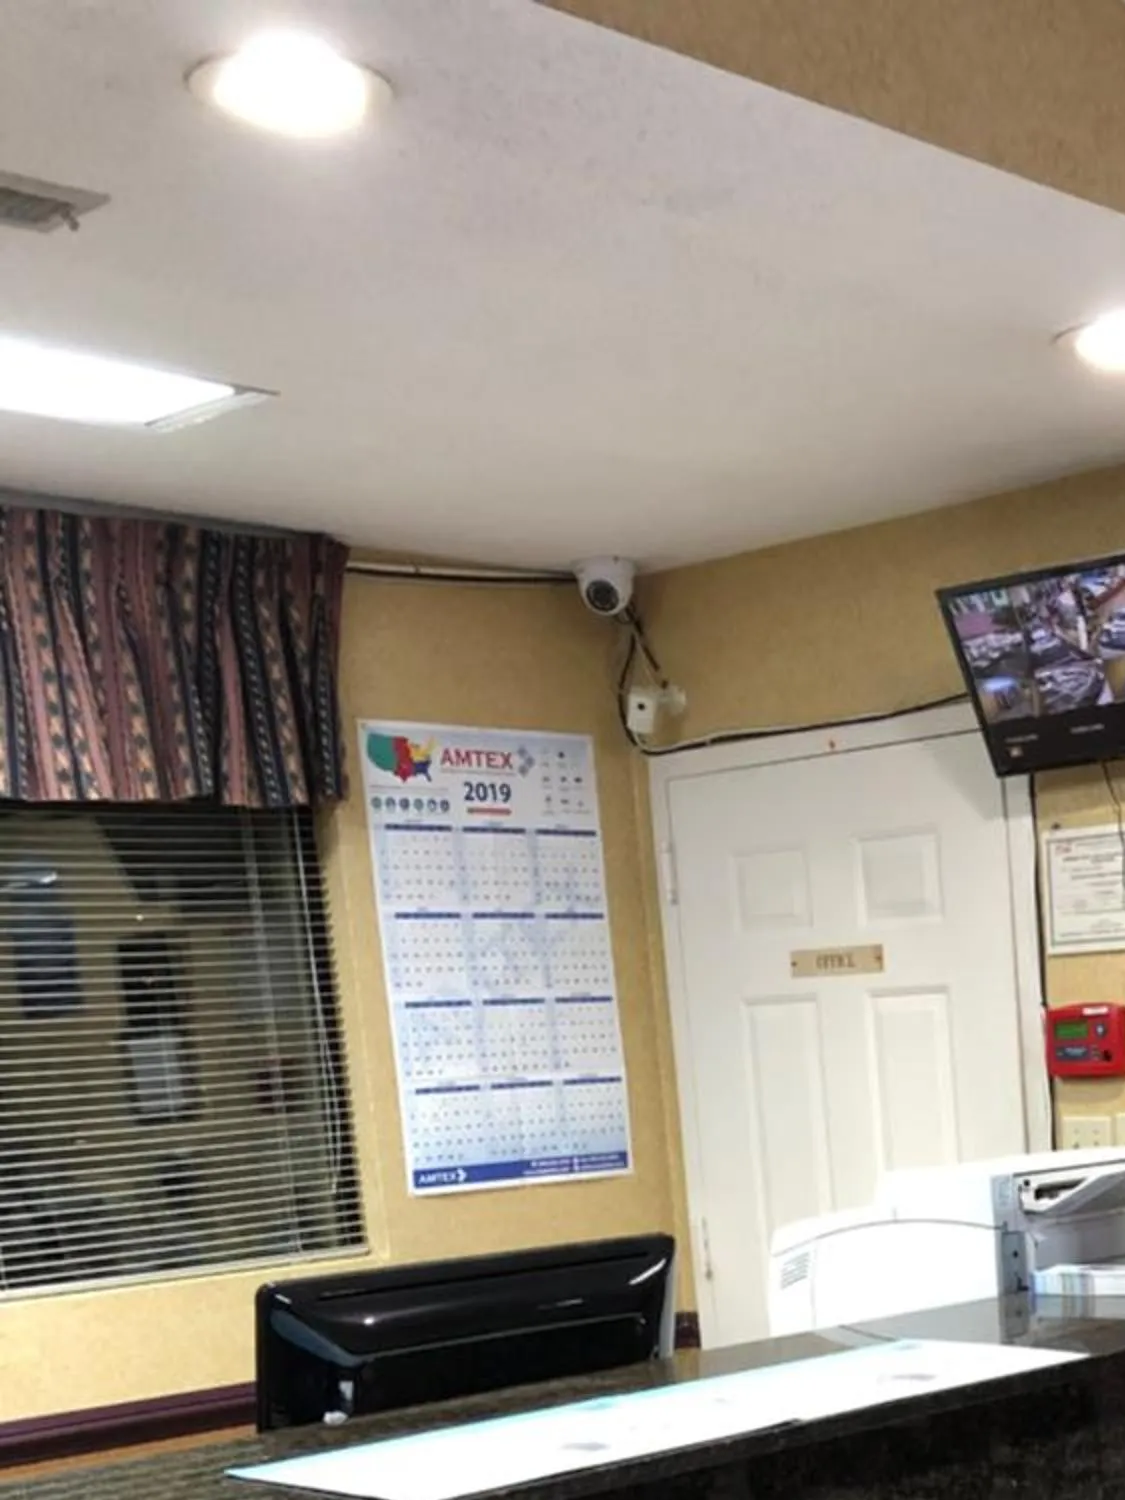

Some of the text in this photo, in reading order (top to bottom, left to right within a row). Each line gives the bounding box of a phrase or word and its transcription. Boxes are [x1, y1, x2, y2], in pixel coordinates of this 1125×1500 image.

[440, 749, 513, 770] AMTEX
[463, 781, 512, 803] 2019
[418, 1171, 456, 1185] AMTEX
